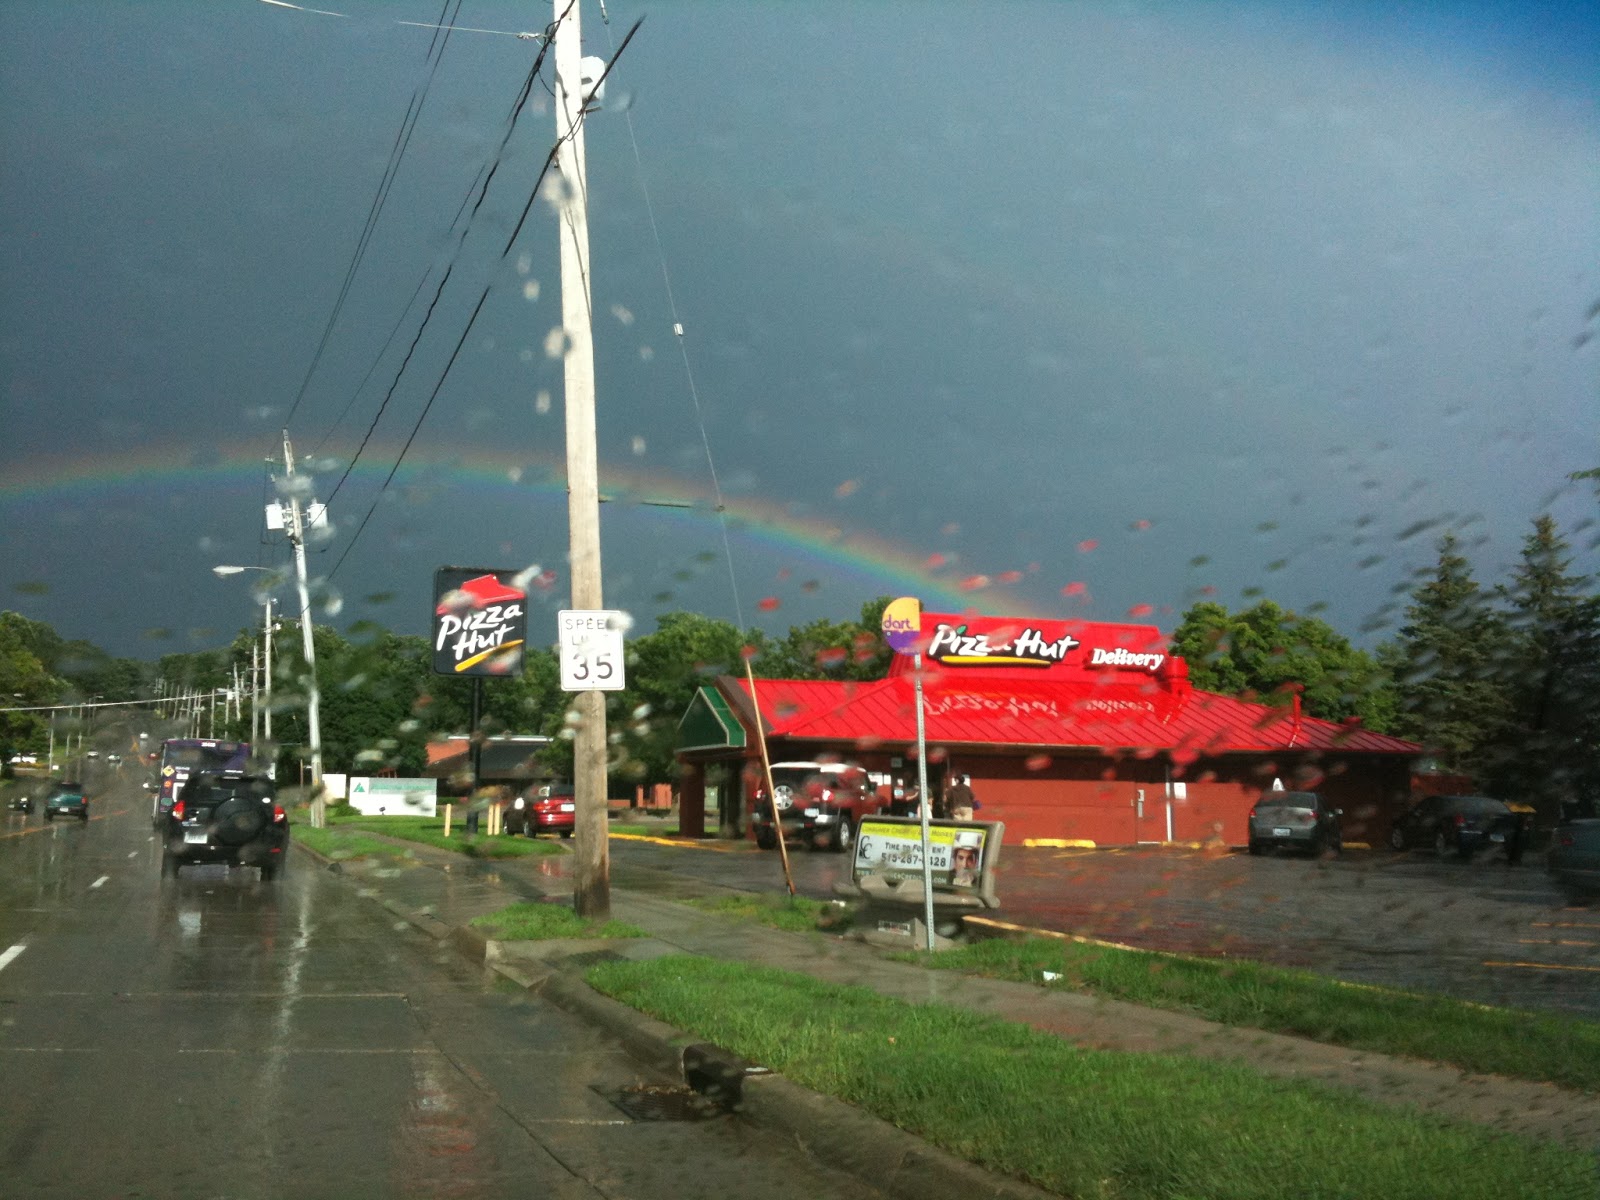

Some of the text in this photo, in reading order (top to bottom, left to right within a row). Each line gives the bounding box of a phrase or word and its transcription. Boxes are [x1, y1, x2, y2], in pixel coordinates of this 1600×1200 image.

[436, 604, 524, 651] Pizza
[565, 618, 614, 630] SPEE
[884, 614, 912, 629] dart
[452, 623, 516, 661] Hut
[1013, 628, 1080, 659] Hut
[573, 651, 613, 681] 35
[1091, 648, 1165, 671] Delivery
[885, 842, 899, 851] TIME
